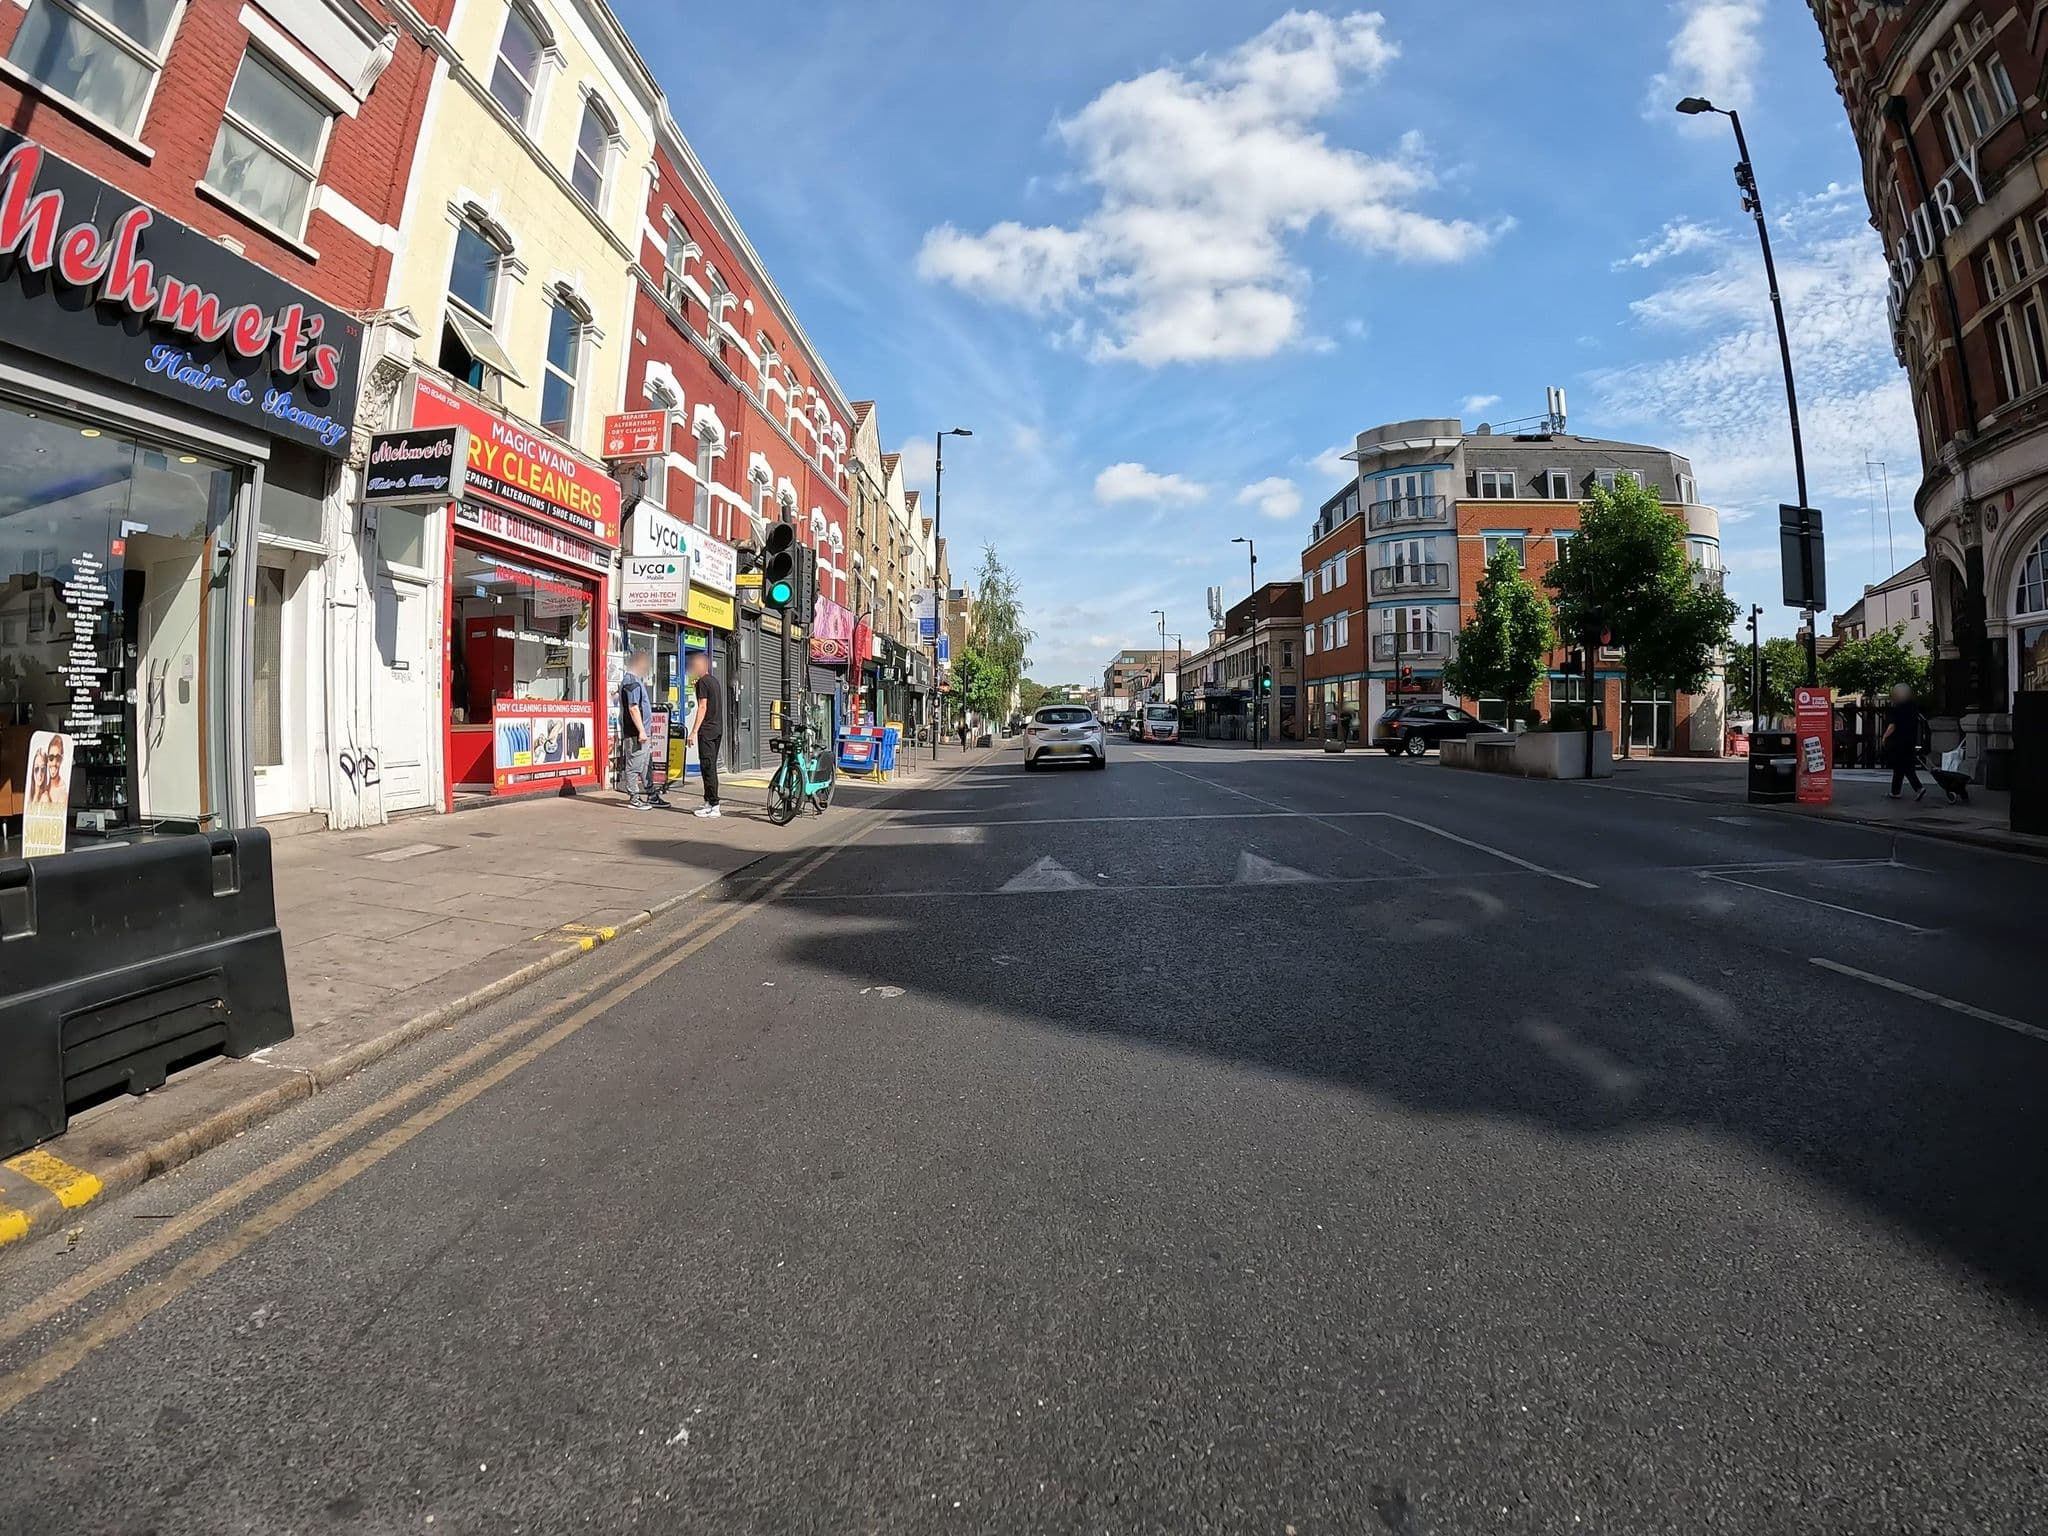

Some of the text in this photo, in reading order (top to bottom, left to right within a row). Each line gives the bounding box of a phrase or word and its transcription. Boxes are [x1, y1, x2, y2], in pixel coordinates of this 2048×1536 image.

[145, 344, 347, 446] Hair & Beauty
[613, 420, 656, 428] ALTERATIONS
[625, 426, 657, 434] CLEANING
[371, 438, 452, 464] Mehmet's
[492, 422, 576, 478] MAGIC WAND
[367, 477, 395, 490] Hair
[408, 474, 448, 490] Beauty
[468, 433, 602, 518] RY CLEANERS
[465, 470, 593, 530] EPAIRS ALTERATIONS SHOE REPAIRS
[481, 506, 502, 533] FREE
[506, 515, 554, 550] COLLECTION
[556, 536, 562, 553] &
[563, 536, 594, 564] DELIVERY
[650, 515, 679, 551] Lyca
[632, 562, 664, 577] Lyca
[496, 703, 511, 713] DRY
[511, 703, 542, 713] CLEANING
[548, 704, 569, 713] IRONING
[569, 704, 592, 713] SERVICE
